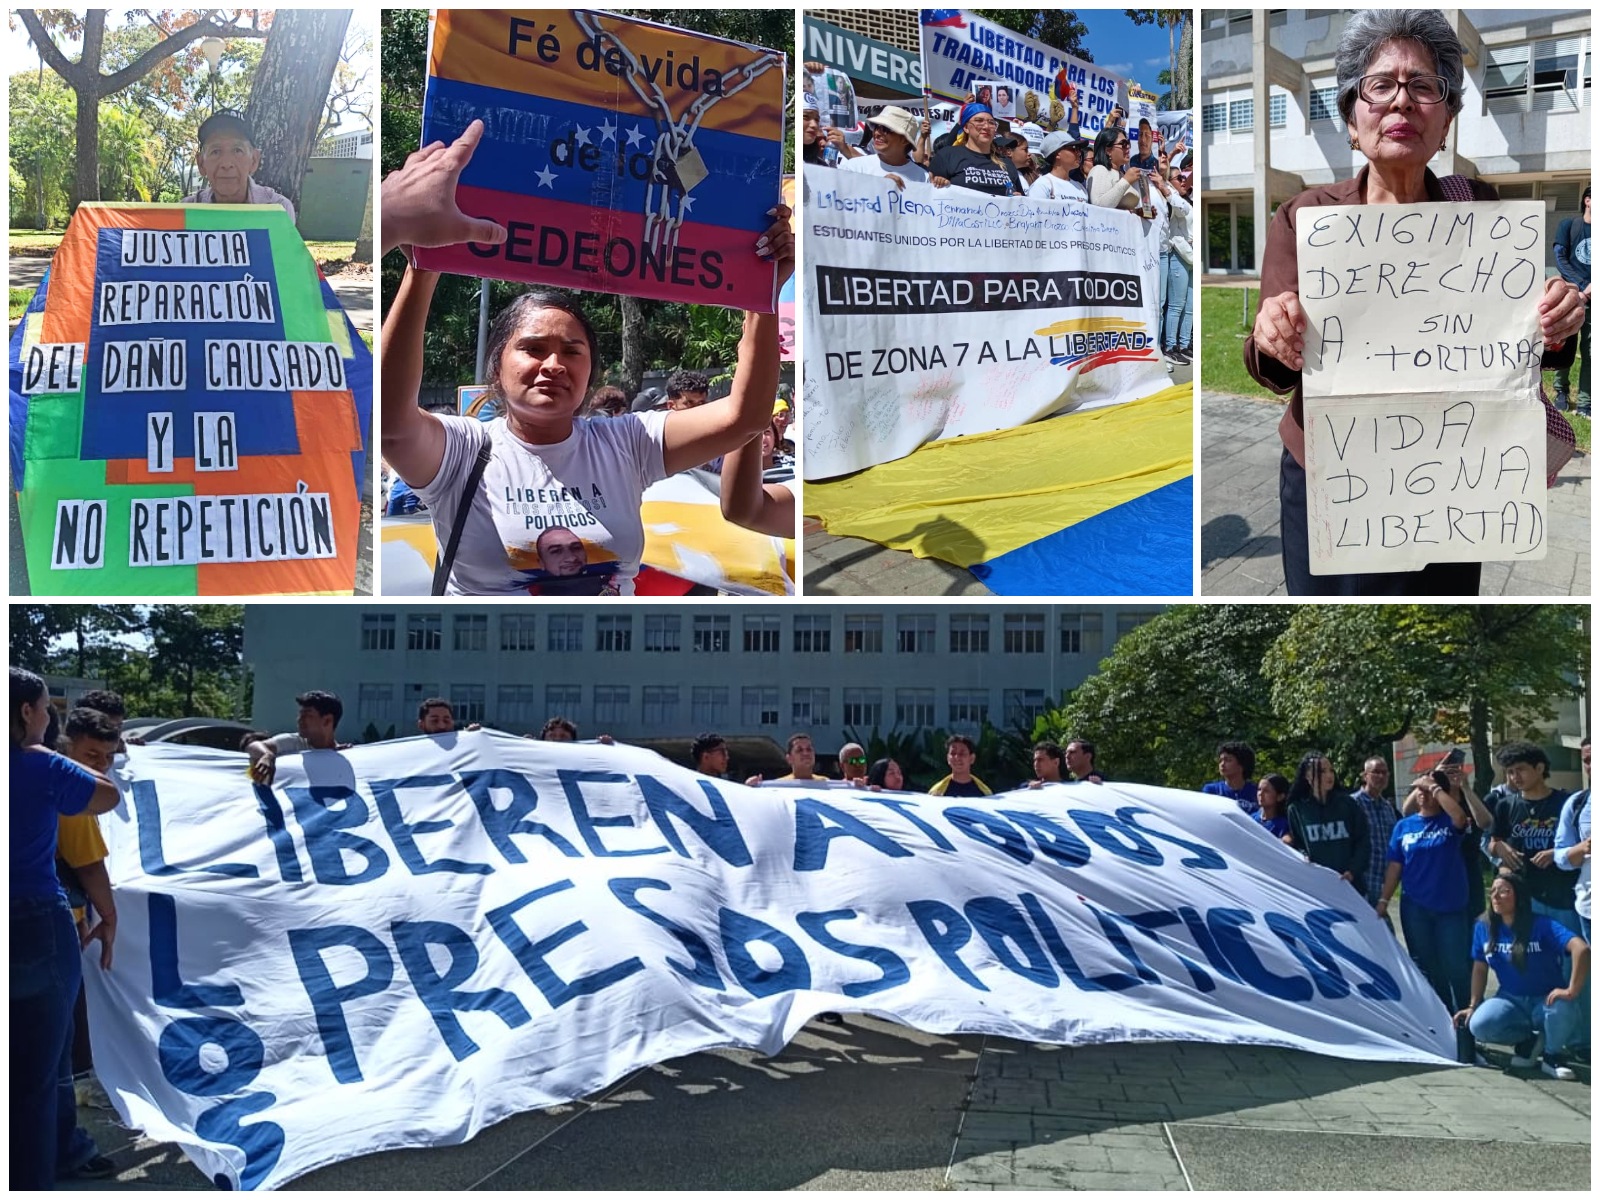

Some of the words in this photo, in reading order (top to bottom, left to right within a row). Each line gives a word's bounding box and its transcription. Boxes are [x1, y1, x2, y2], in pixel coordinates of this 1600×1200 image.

[508, 17, 560, 63] Fé
[576, 34, 626, 76] de
[640, 50, 724, 97] vida
[932, 32, 1054, 95] TRABAJADORE
[970, 21, 1044, 69] LIBERTAD
[1091, 73, 1115, 96] LOS
[943, 109, 955, 122] DE
[549, 130, 601, 172] de
[124, 232, 248, 264] JUSTICIA
[813, 225, 893, 244] ESTUDIANTES
[894, 235, 937, 247] UNIDOS
[940, 237, 965, 248] POR
[968, 238, 982, 248] LA
[984, 239, 1033, 250] LIBERTAD
[1036, 240, 1047, 250] DE
[1050, 240, 1068, 250] LOS
[1070, 241, 1101, 251] PRESOS
[1307, 211, 1541, 251] EXIGIMOS
[103, 273, 274, 323] REPARACIÓN
[824, 274, 974, 306] LIBERTAD
[984, 278, 1063, 304] PARA
[1068, 277, 1140, 302] TODOS
[1305, 252, 1536, 300] DERECHO
[1418, 313, 1473, 334] SIN
[25, 345, 83, 391] DEL
[106, 338, 184, 389] DAÑO
[208, 342, 344, 388] CAUSADO
[825, 351, 863, 382] DE
[872, 344, 947, 376] ZONA
[952, 342, 970, 367] 7
[977, 341, 998, 365] A
[1005, 337, 1042, 361] LA
[1049, 330, 1148, 359] LIBERTAD
[151, 416, 170, 469] Y
[198, 415, 235, 468] LA
[1325, 401, 1476, 461] VIDA
[505, 486, 583, 503] LIBEREN
[591, 482, 603, 498] A
[1326, 445, 1531, 504] DIGNA
[56, 503, 102, 565] NO
[133, 480, 334, 563] REPETICIÓN
[1336, 501, 1543, 555] LIBERTAD
[132, 768, 754, 887] LIBEREN
[792, 796, 916, 872] A
[866, 796, 1229, 871] TODOS
[1305, 820, 1350, 843] UMA
[1524, 837, 1550, 850] UCV
[287, 877, 910, 1084] PRESOS
